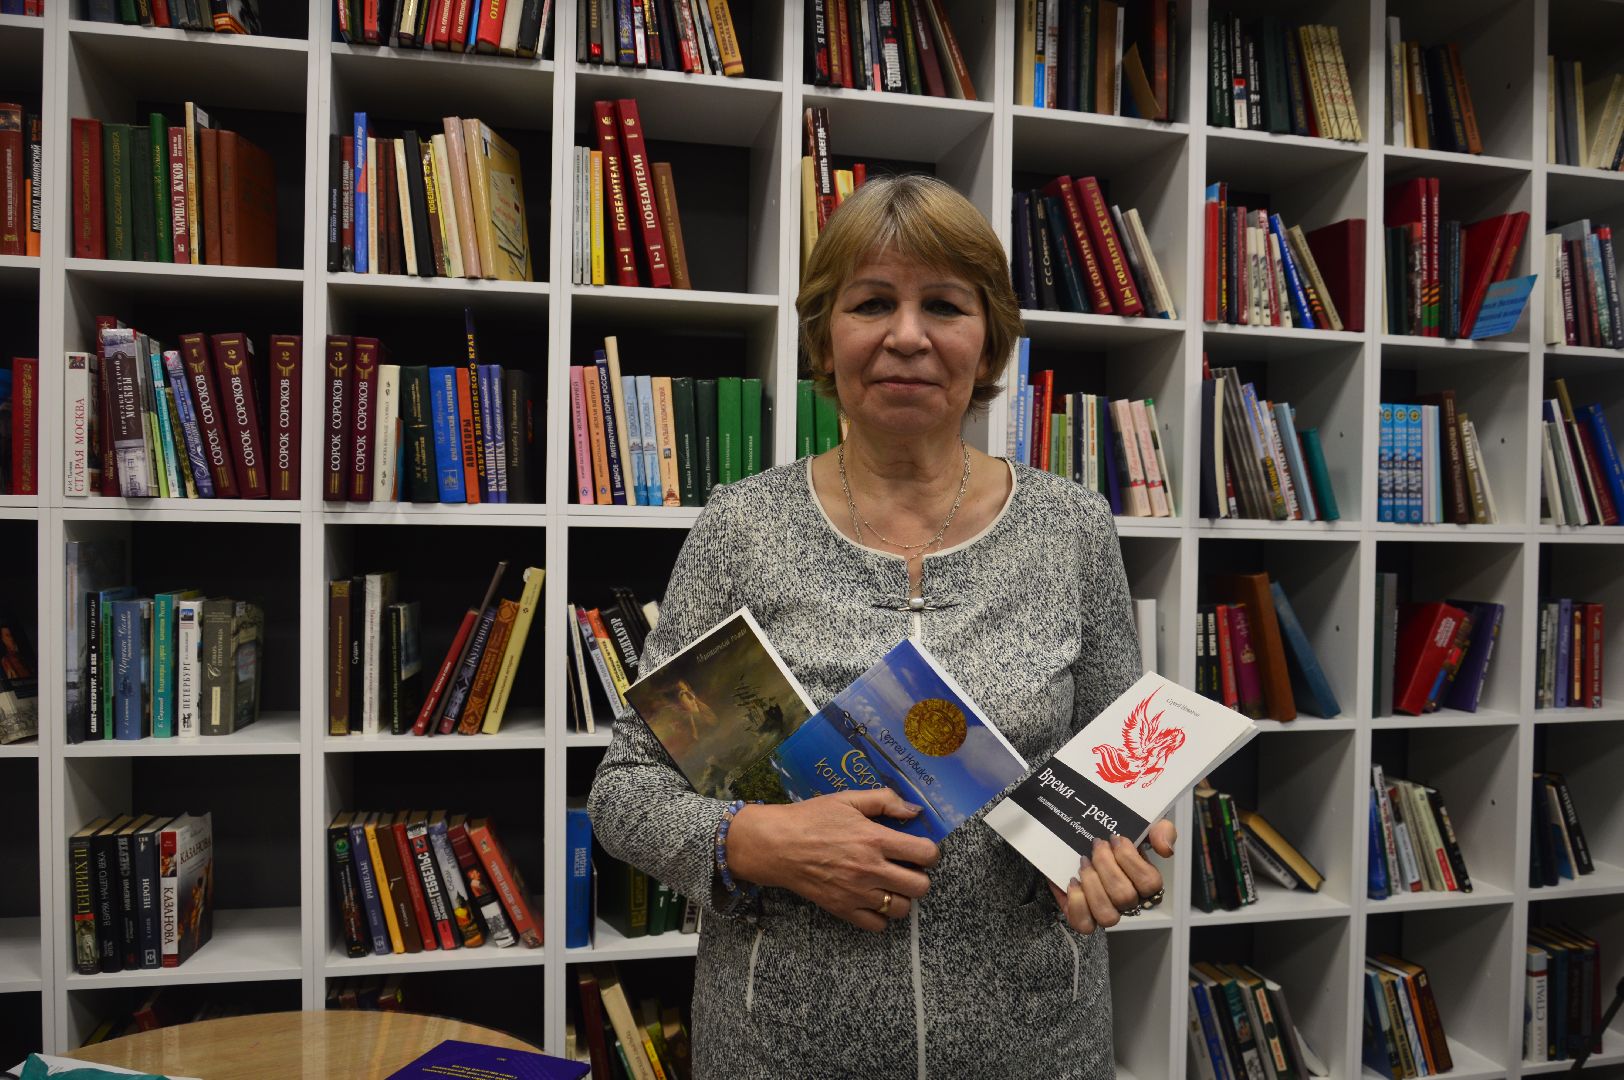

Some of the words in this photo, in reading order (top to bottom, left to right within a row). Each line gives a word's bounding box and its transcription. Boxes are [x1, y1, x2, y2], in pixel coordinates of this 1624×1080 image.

[818, 128, 827, 156] ВСЕГДА
[172, 162, 185, 193] ЖУКОВ
[608, 156, 627, 231] ПОБЕДИТЕЛИ
[633, 154, 656, 229] ПОБЕДИТЕЛИ
[821, 157, 830, 193] ПОМНИТЬ
[173, 196, 186, 235] МАРШАЛ
[1098, 217, 1113, 236] XX
[1080, 239, 1102, 287] СОЛДАТЫ
[1104, 237, 1127, 285] СОЛДАТЫ
[114, 360, 123, 391] СТАРОЙ
[600, 367, 610, 394] РОССИИ
[119, 394, 127, 435] ПЕРЕУЛКИ
[122, 377, 136, 418] МОСКВЫ
[194, 374, 215, 424] СОРОКОВ
[230, 376, 248, 425] СОРОКОВ
[280, 379, 290, 427] СОРОКОВ
[331, 380, 342, 429] СОРОКОВ
[356, 382, 368, 430] СОРОКОВ
[468, 362, 482, 436] ВИДНОВСКОГО
[603, 395, 612, 414] ГОРОД
[74, 398, 84, 445] МОСКВА
[605, 414, 618, 459] ЛИТЕРАТУРНЫЙ
[206, 427, 224, 466] СОРОК
[240, 429, 255, 467] СОРОК
[279, 432, 289, 468] СОРОК
[330, 434, 340, 471] СОРОК
[355, 436, 366, 472] СОРОК
[463, 419, 474, 467] АВИАТОРЫ
[74, 450, 84, 492] СТАРАЯ
[485, 441, 498, 492] БАЛАШИХА
[496, 441, 507, 491] БАЛАШИХА
[612, 464, 621, 488] ВИДНОЕ
[118, 639, 131, 674] Царское
[352, 641, 360, 665] Суздаль
[463, 618, 492, 665] Купчино
[610, 617, 639, 668] ЭЙЗЕНХАУЭР
[183, 661, 191, 709] ПЕТЕРБУРГ
[1166, 698, 1182, 709] Сергей
[879, 728, 905, 754] Сергей
[904, 753, 936, 787] Новиков
[1037, 766, 1075, 800] Время
[1037, 795, 1071, 828] поэтический
[1069, 821, 1096, 842] сборник
[97, 851, 107, 869] ВЕКА
[117, 837, 131, 877] СМЕРТИ
[418, 851, 441, 898] ГЕББЕЛЬС
[74, 860, 90, 914] ГЕНРИХ
[98, 871, 109, 899] НАШЕГО
[123, 879, 131, 911] ИМПЕРИЯ
[142, 878, 151, 909] НЕРОН
[361, 860, 375, 899] РИШЕЛЬЕ
[164, 887, 174, 944] КАЗАНОВА
